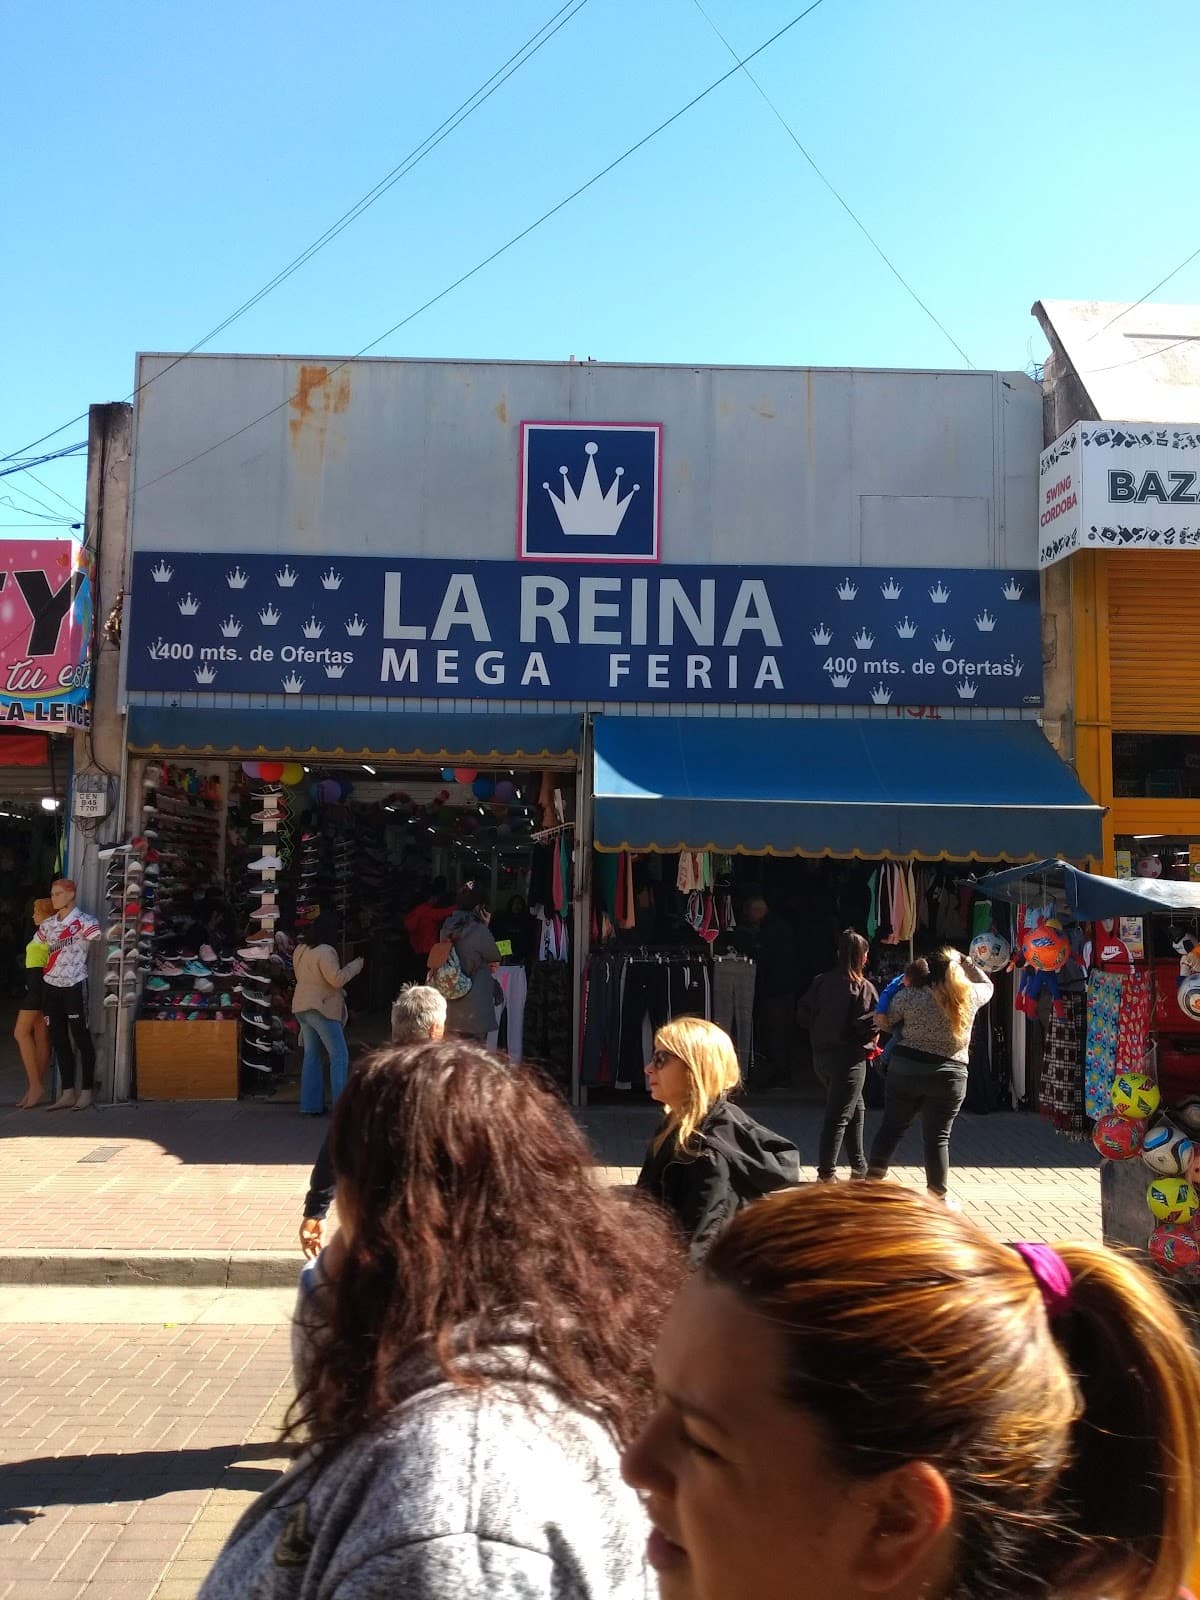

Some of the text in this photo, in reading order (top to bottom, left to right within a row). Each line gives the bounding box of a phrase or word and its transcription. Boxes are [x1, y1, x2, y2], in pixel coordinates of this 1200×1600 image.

[1046, 474, 1072, 505] SWING
[1108, 469, 1200, 505] BAZ
[1040, 493, 1078, 528] CORDOBA
[0, 570, 87, 658] Y
[383, 571, 783, 647] LA REINA
[159, 643, 354, 664] 400 mts. de Ofertas
[380, 647, 784, 689] MEGA FERIA
[822, 657, 1014, 677] 400 mts. de Ofertas
[6, 659, 48, 691] tu
